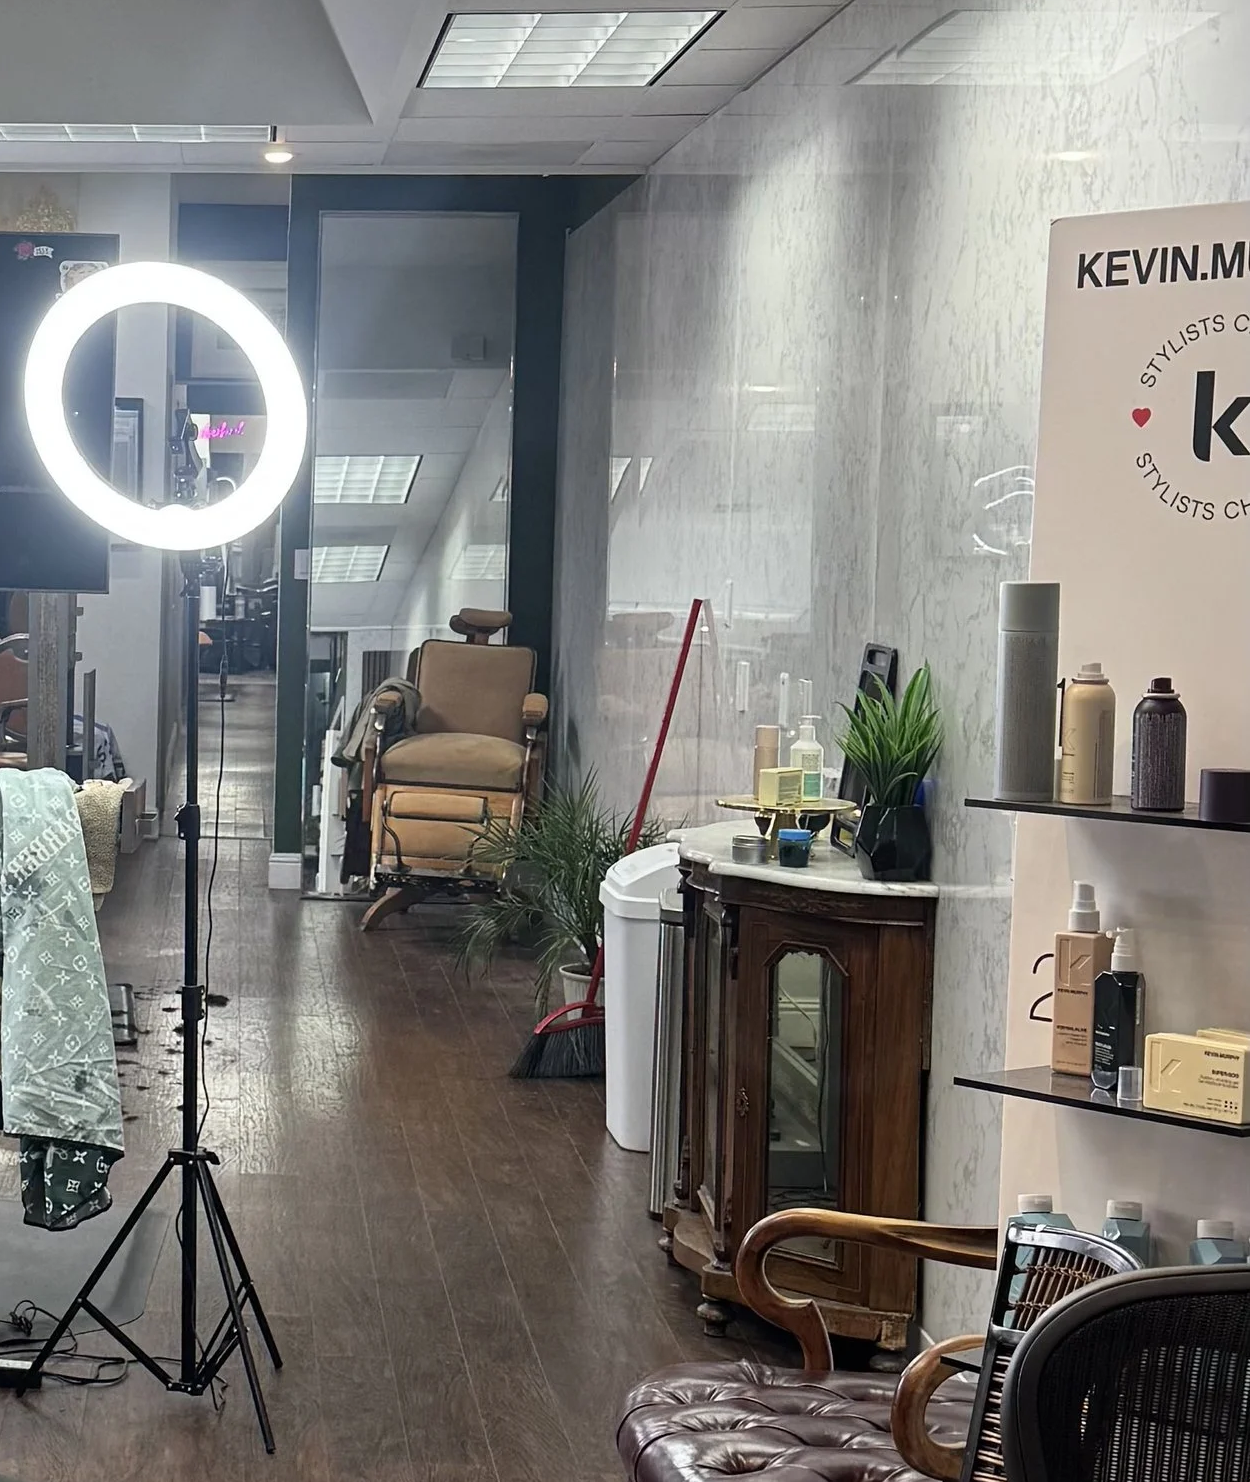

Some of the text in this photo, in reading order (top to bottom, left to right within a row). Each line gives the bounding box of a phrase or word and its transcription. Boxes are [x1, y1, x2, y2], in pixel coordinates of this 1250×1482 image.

[1077, 240, 1250, 289] KEVIN.M
[1140, 314, 1225, 388] STYLISTS
[1136, 452, 1215, 521] STYLISTS
